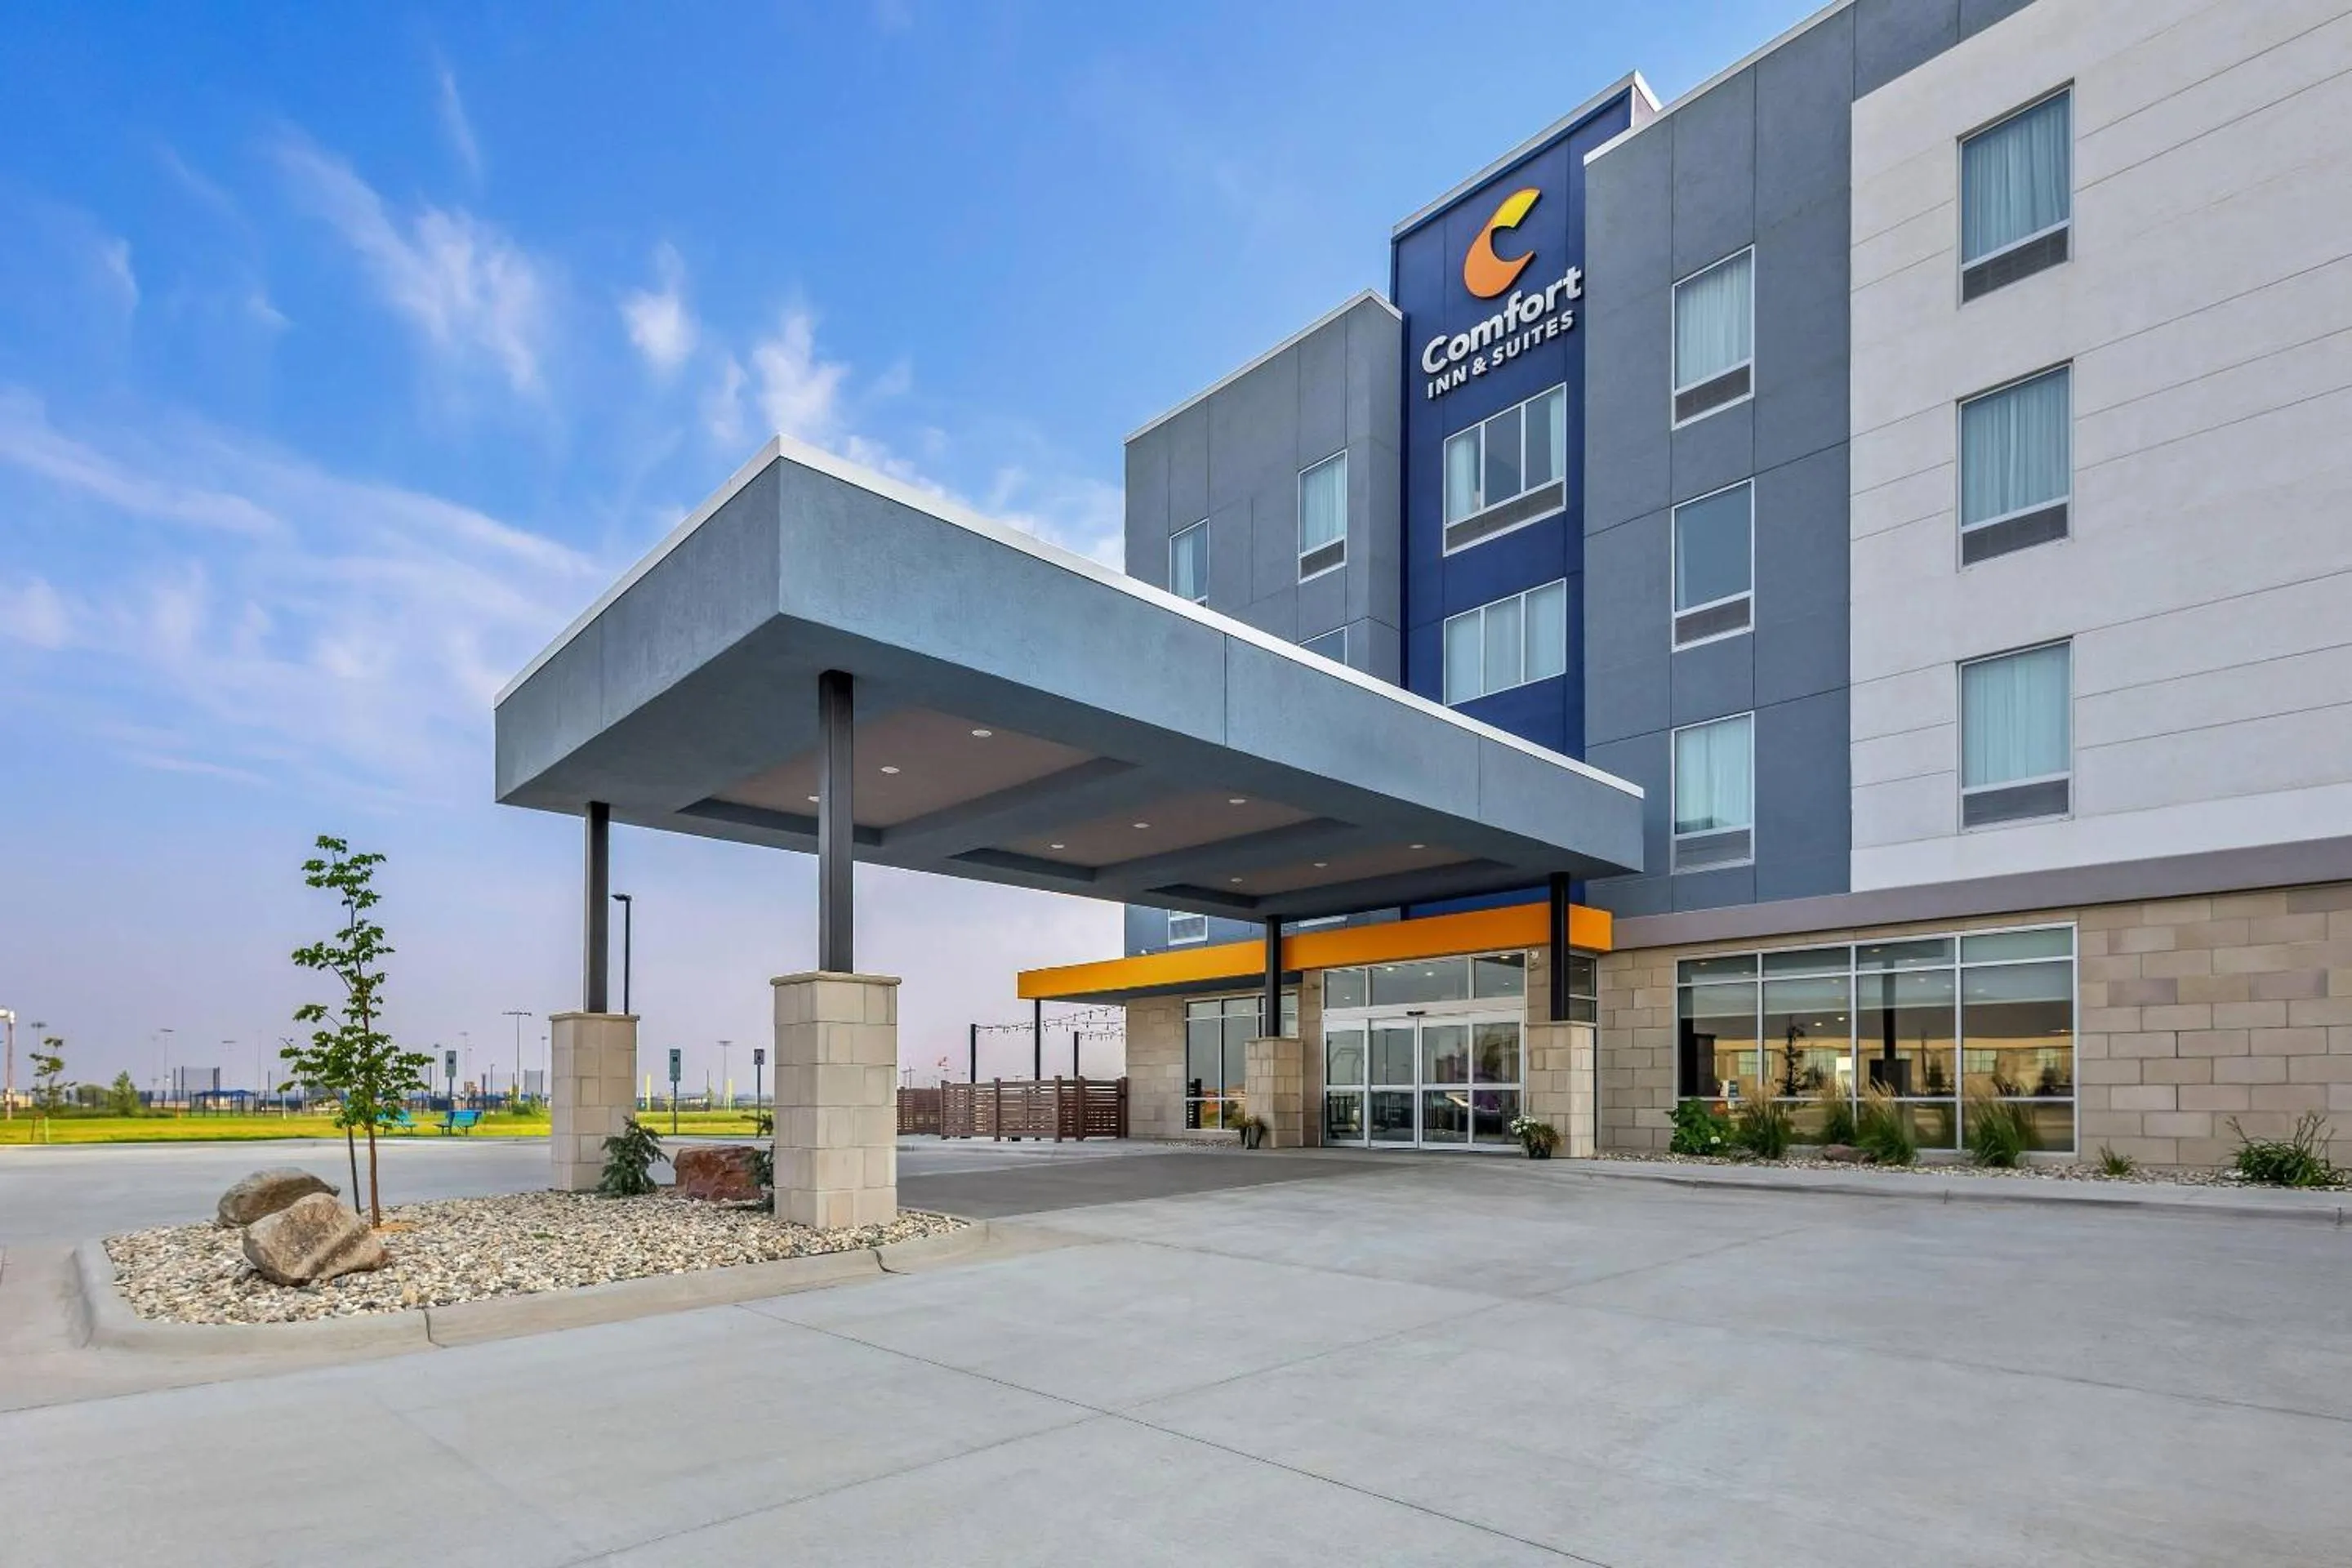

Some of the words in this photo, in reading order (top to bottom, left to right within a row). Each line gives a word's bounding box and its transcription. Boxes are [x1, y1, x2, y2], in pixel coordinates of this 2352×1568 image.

[1422, 266, 1582, 373] Comfort
[1428, 366, 1467, 399] INN
[1472, 358, 1487, 375] &
[1492, 310, 1574, 366] SUITES
